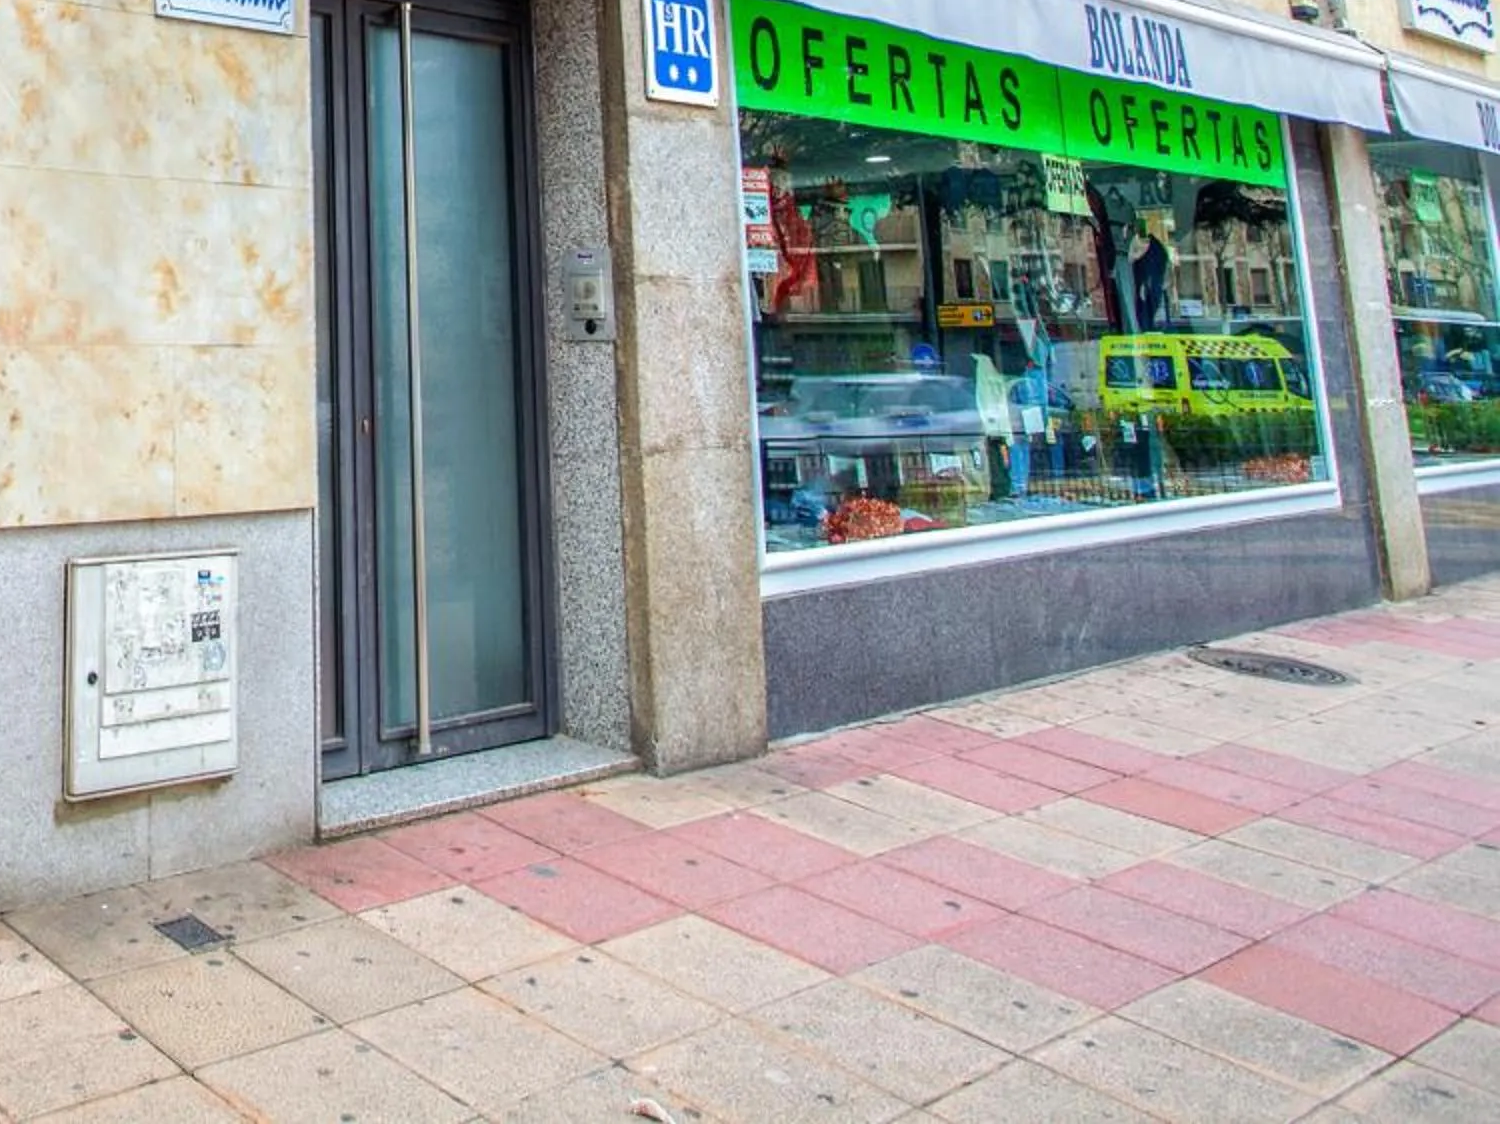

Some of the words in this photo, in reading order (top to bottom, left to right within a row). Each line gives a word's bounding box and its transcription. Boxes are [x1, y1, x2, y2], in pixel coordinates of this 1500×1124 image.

[750, 15, 1022, 131] OFERTAS
[1088, 87, 1272, 171] OFERTAS
[1084, 3, 1192, 88] BOLANDA
